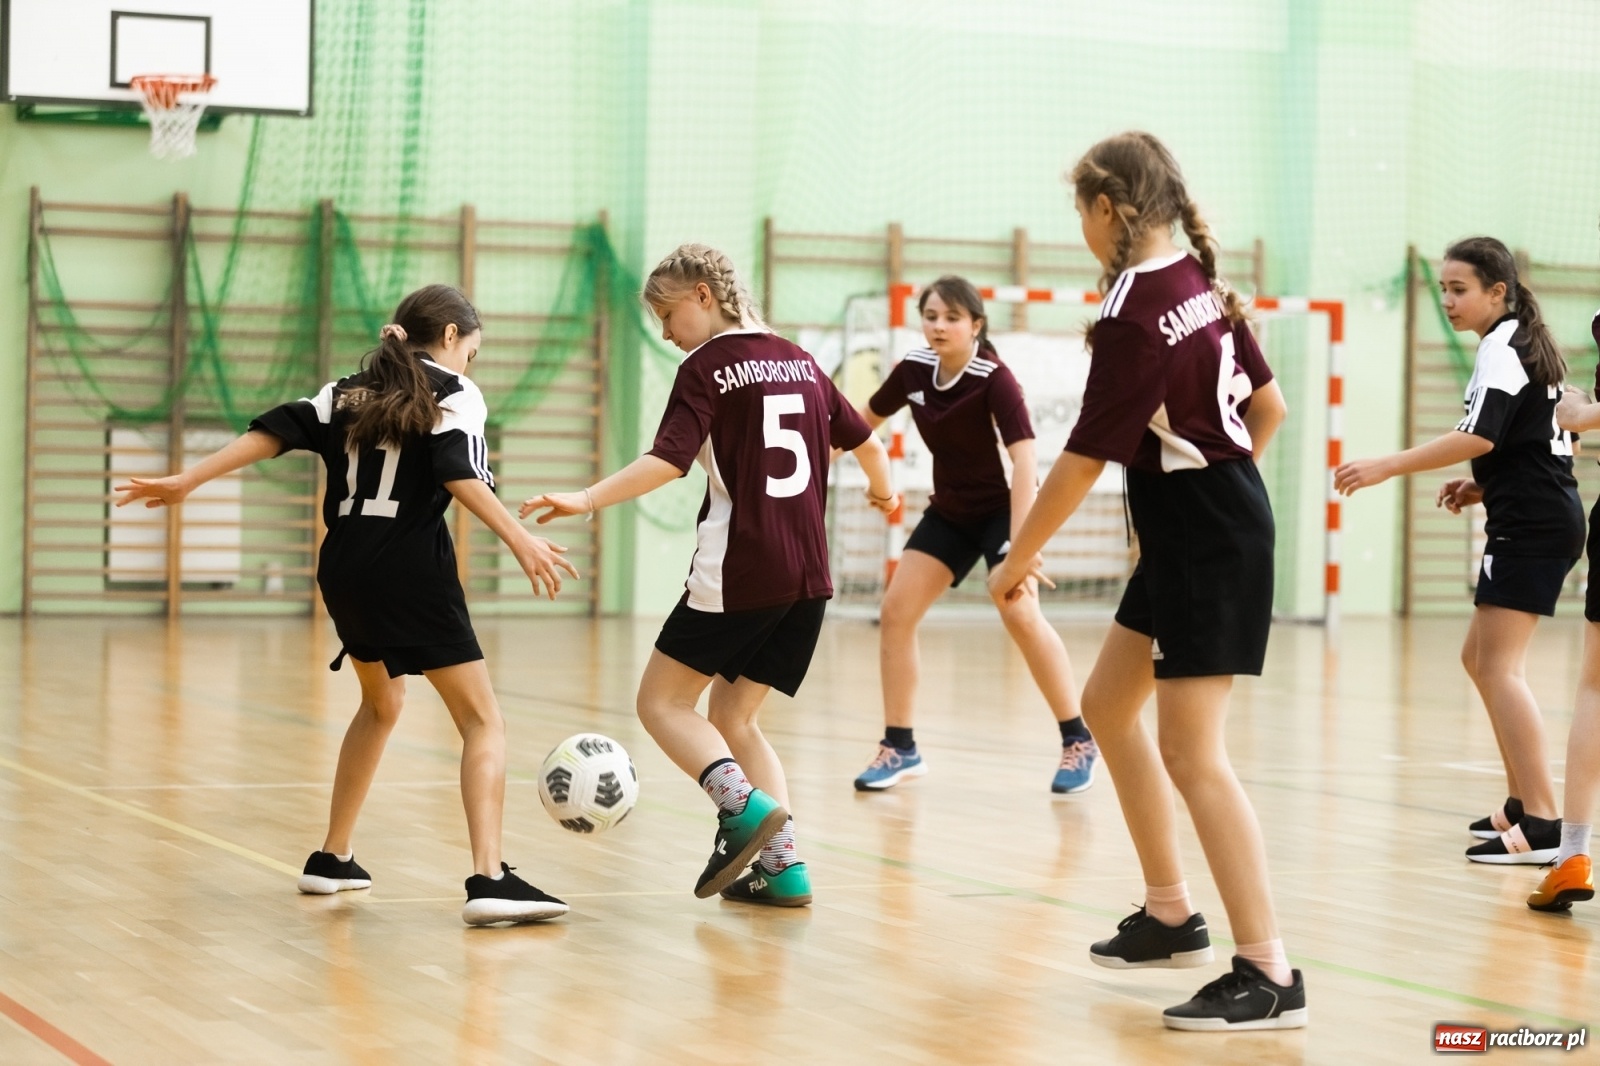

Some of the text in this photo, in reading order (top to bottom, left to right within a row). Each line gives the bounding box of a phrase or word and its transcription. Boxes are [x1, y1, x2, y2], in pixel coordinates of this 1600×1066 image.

[1217, 331, 1253, 452] 6
[338, 440, 402, 519] 11
[762, 393, 811, 498] 5
[748, 877, 768, 893] FILA
